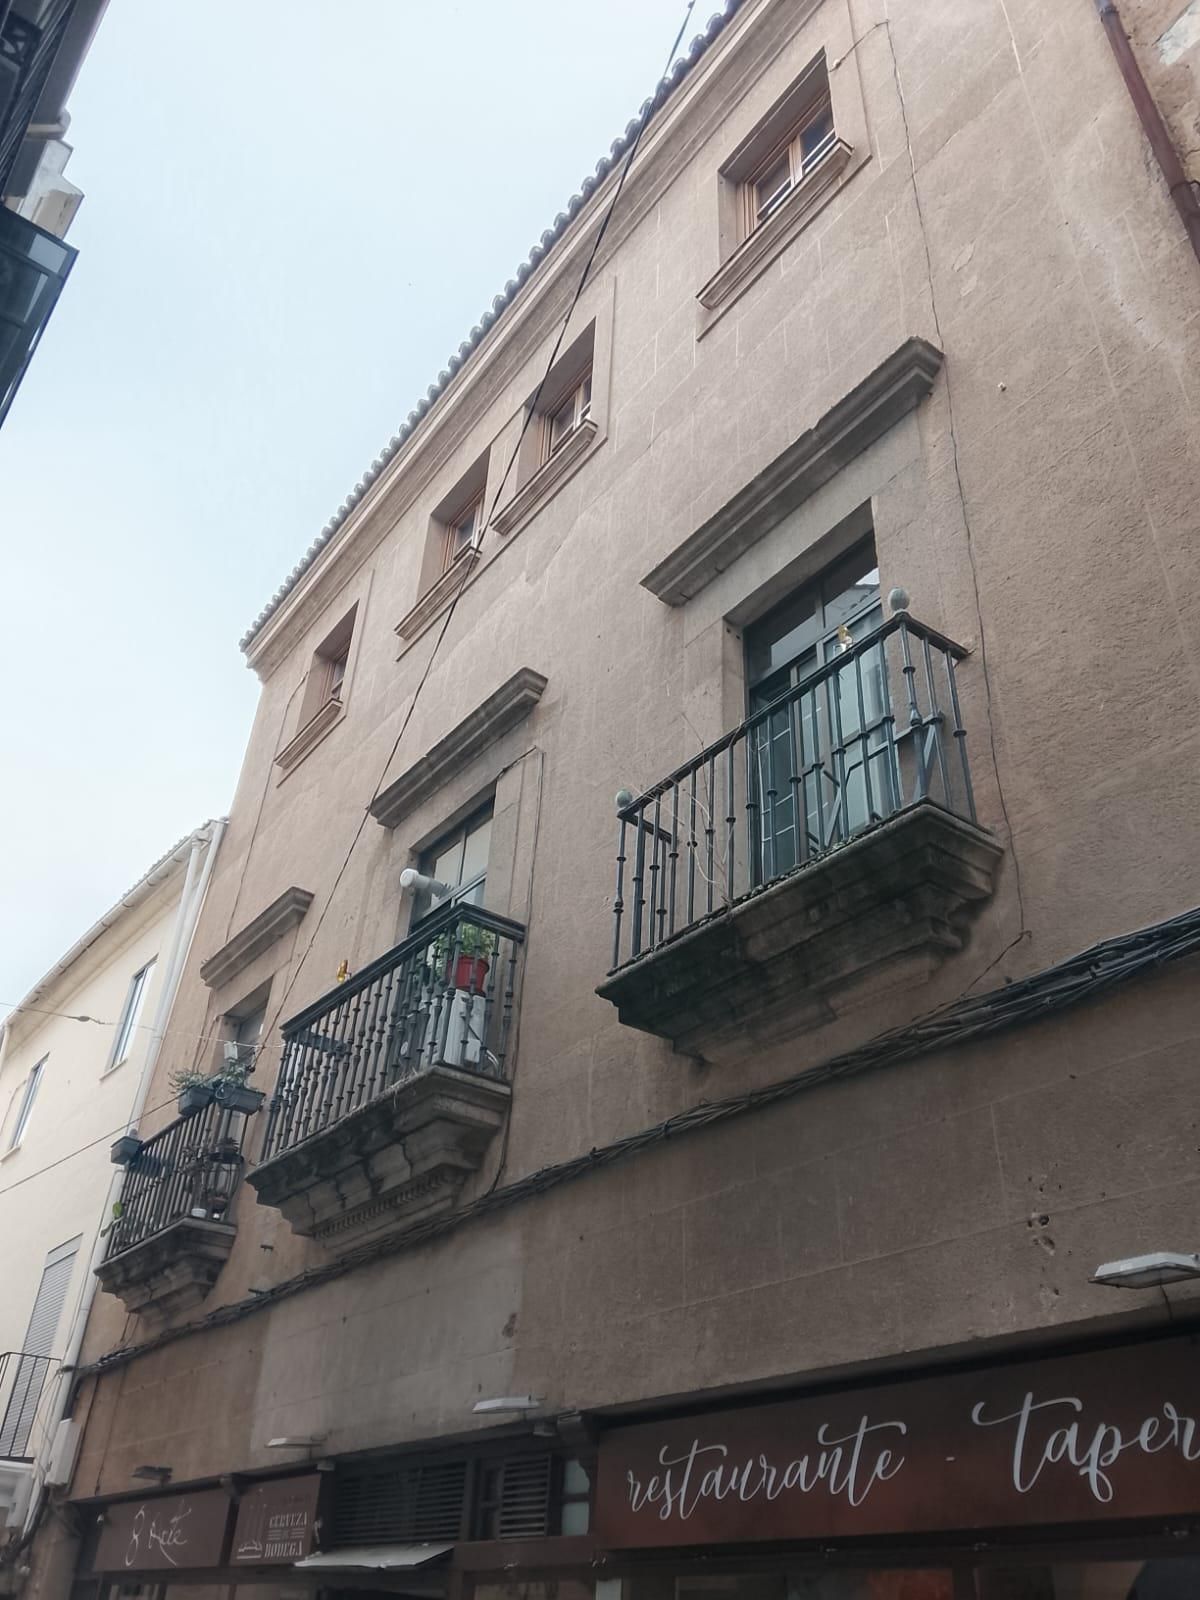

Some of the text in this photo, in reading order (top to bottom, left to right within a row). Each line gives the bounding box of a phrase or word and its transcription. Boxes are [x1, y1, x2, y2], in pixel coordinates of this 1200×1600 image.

[627, 1415, 907, 1520] restaurante
[971, 1391, 1200, 1503] taper
[269, 1512, 307, 1529] CERVEZA
[264, 1540, 303, 1558] BODEGA
